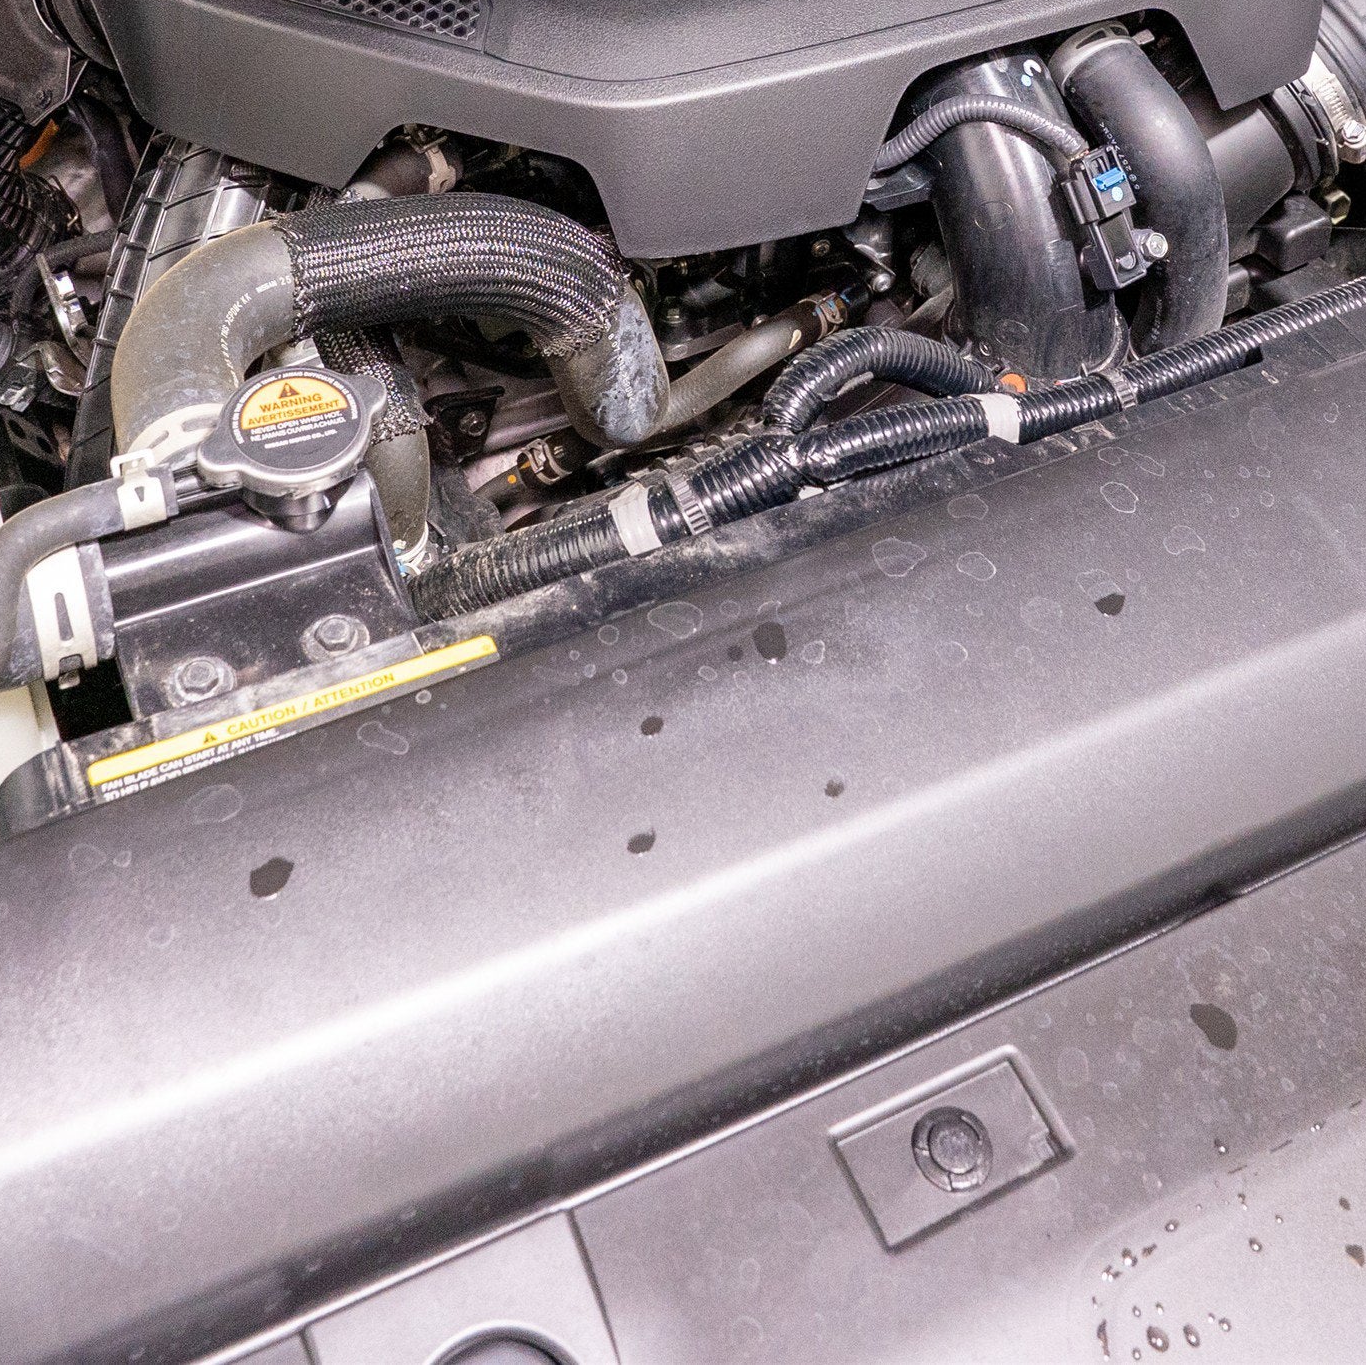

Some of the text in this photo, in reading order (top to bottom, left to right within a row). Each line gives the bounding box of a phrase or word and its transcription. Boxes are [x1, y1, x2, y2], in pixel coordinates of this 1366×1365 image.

[248, 399, 340, 426] AVERTISSEMENT
[259, 393, 322, 413] WARNING
[250, 424, 276, 435] NEVER
[278, 419, 299, 429] OPEN
[300, 414, 325, 424] WHEN
[226, 704, 297, 736] CAUTION
[313, 671, 395, 710] ATTENTION
[101, 779, 123, 794] FAN
[158, 760, 184, 774] CAN
[183, 749, 216, 767] START
[216, 744, 230, 755] AT
[230, 736, 253, 751] ANY
